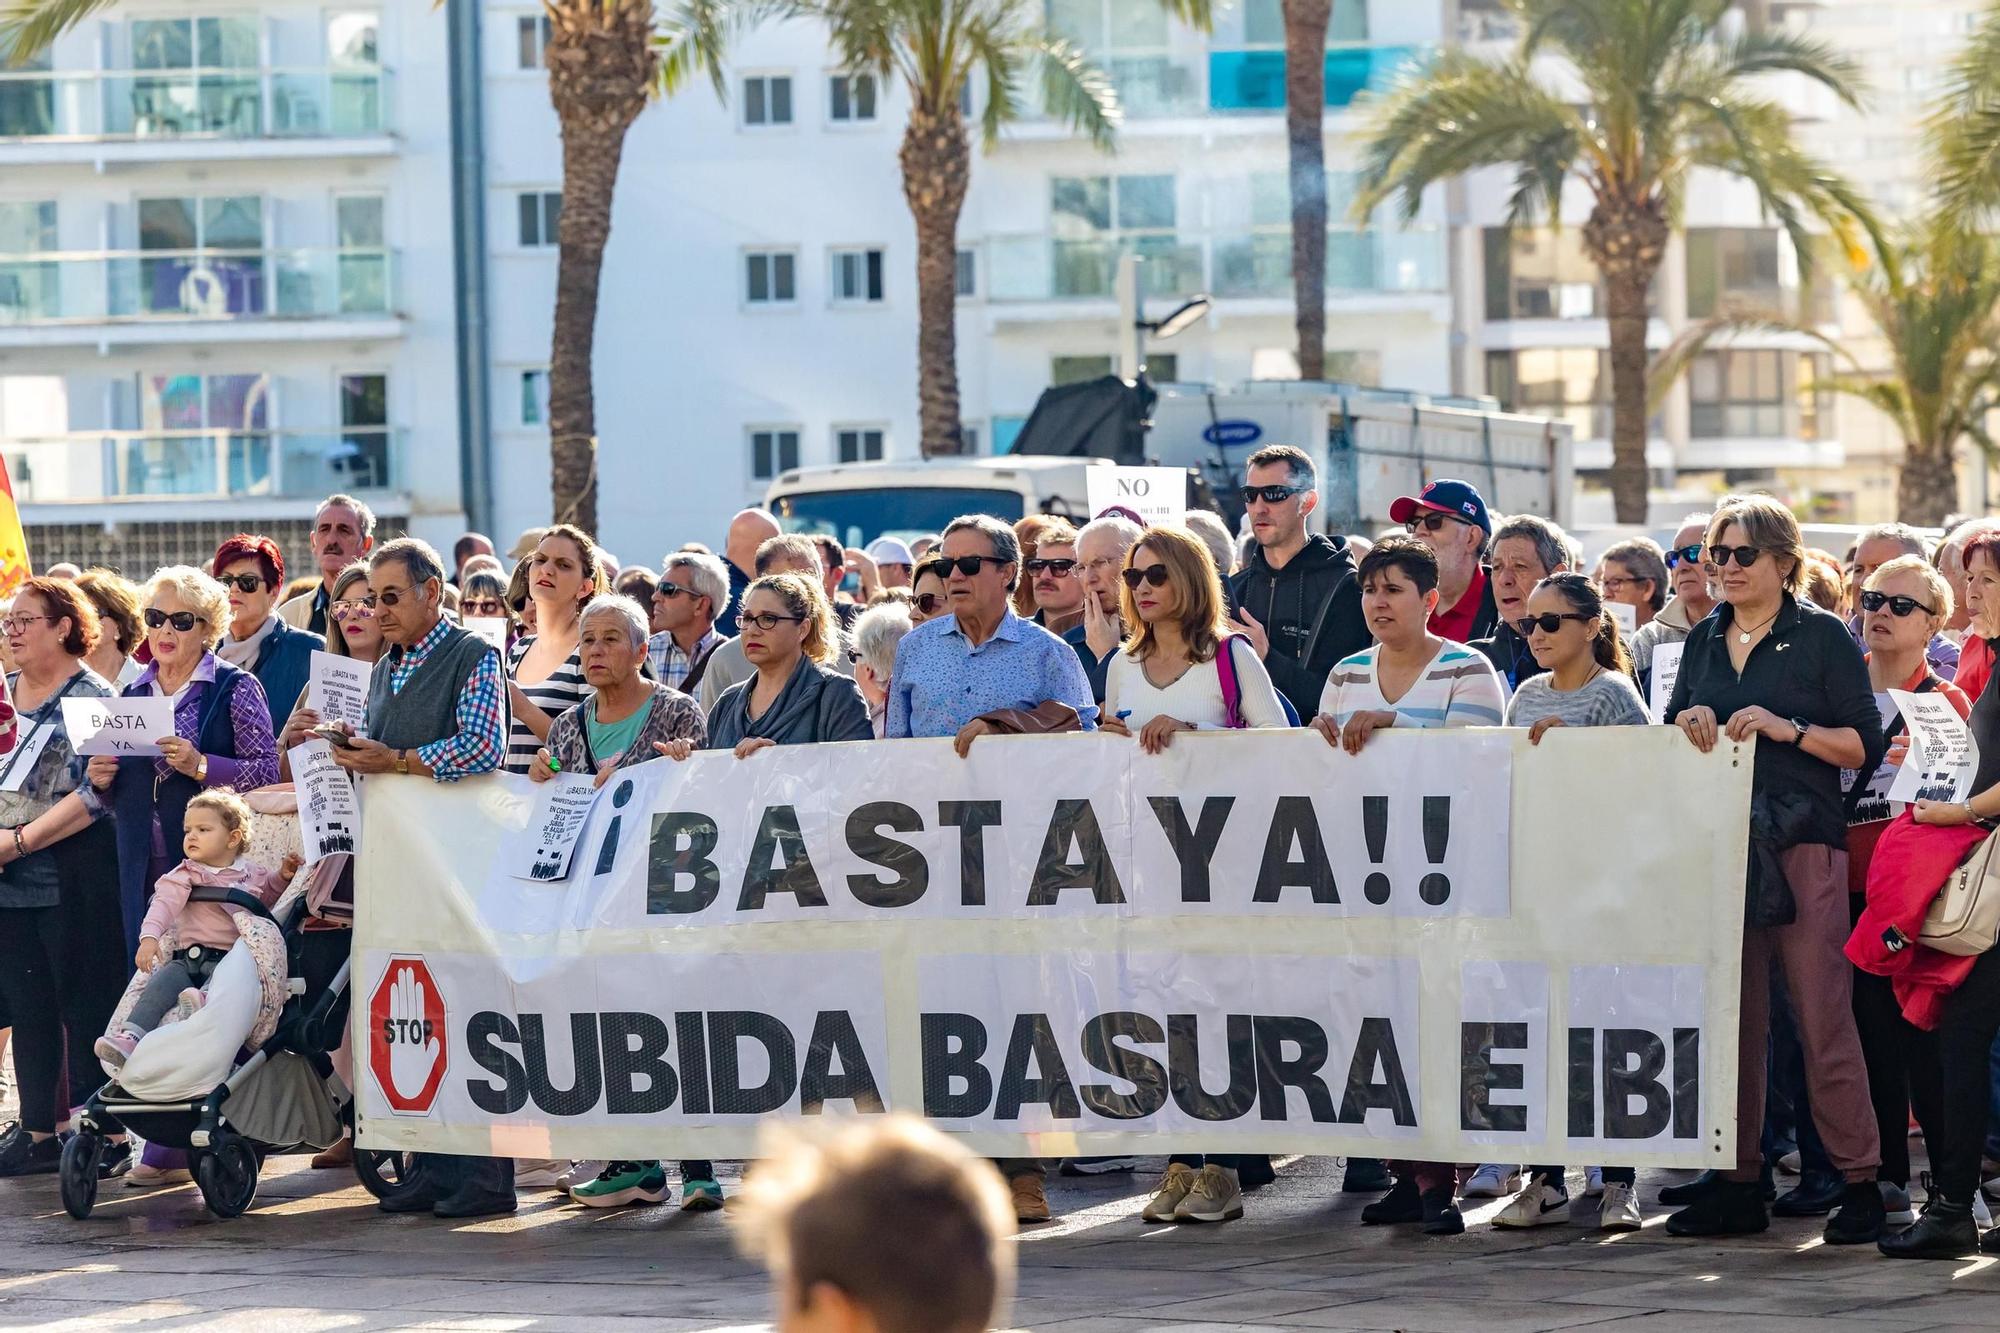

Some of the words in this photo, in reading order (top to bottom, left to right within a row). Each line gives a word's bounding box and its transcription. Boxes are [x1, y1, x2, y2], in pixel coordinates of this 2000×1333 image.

[1117, 479, 1149, 496] NO
[91, 715, 146, 729] BASTA
[111, 740, 135, 750] YA
[1147, 796, 1450, 905] YA!!
[384, 1019, 433, 1046] STOP
[467, 1010, 885, 1116] SUBIDA
[921, 1012, 1418, 1128] BASURA
[1461, 1022, 1528, 1132] E
[1568, 1028, 1699, 1138] IBI
